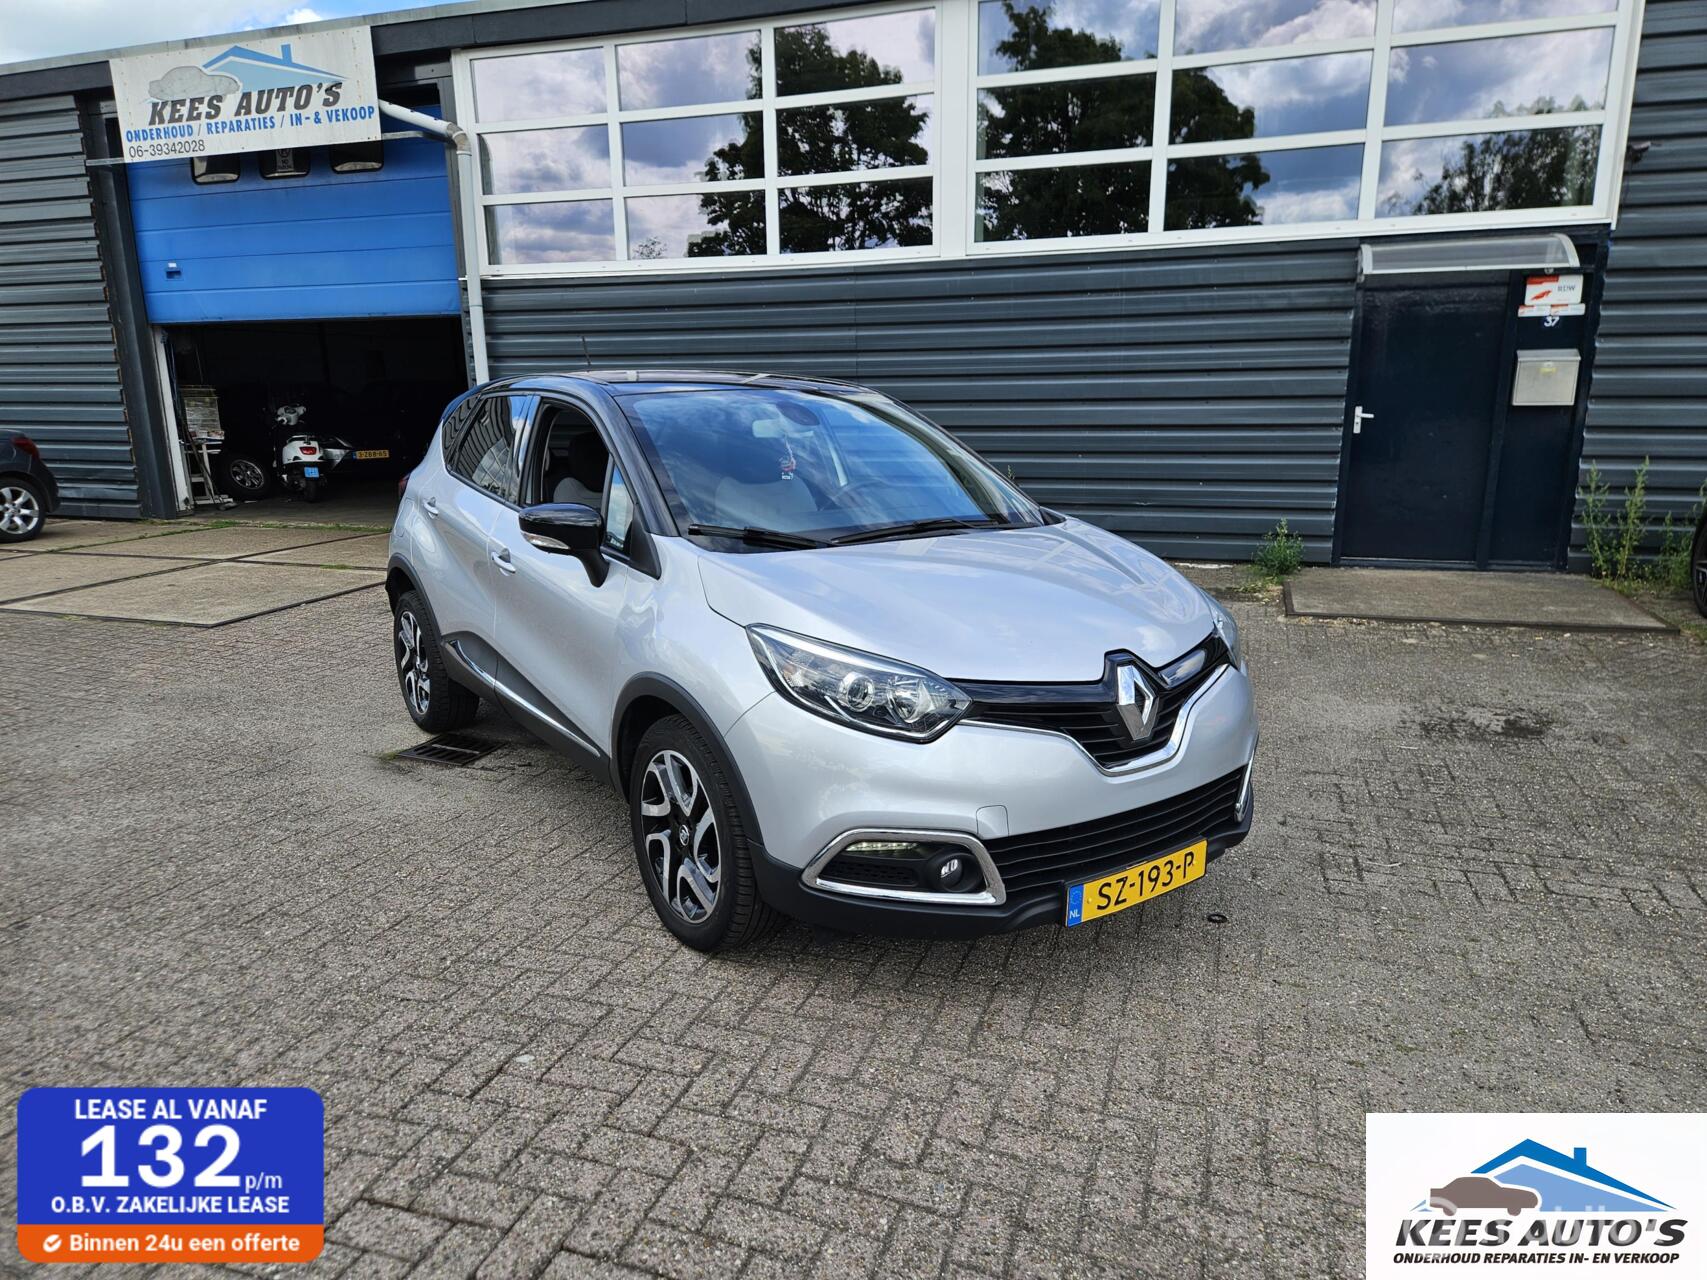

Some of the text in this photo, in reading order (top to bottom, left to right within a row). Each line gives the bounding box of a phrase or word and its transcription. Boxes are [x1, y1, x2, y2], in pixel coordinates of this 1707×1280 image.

[148, 82, 342, 126] KEES AUTO'S
[126, 124, 194, 143] ONDERHOUD
[206, 116, 276, 135] REPARATIES
[326, 106, 375, 124] VEKOOP
[128, 140, 206, 158] 06-39342028
[1544, 316, 1560, 327] 37
[1096, 851, 1195, 910] SZ-193-P
[1069, 908, 1080, 919] NL
